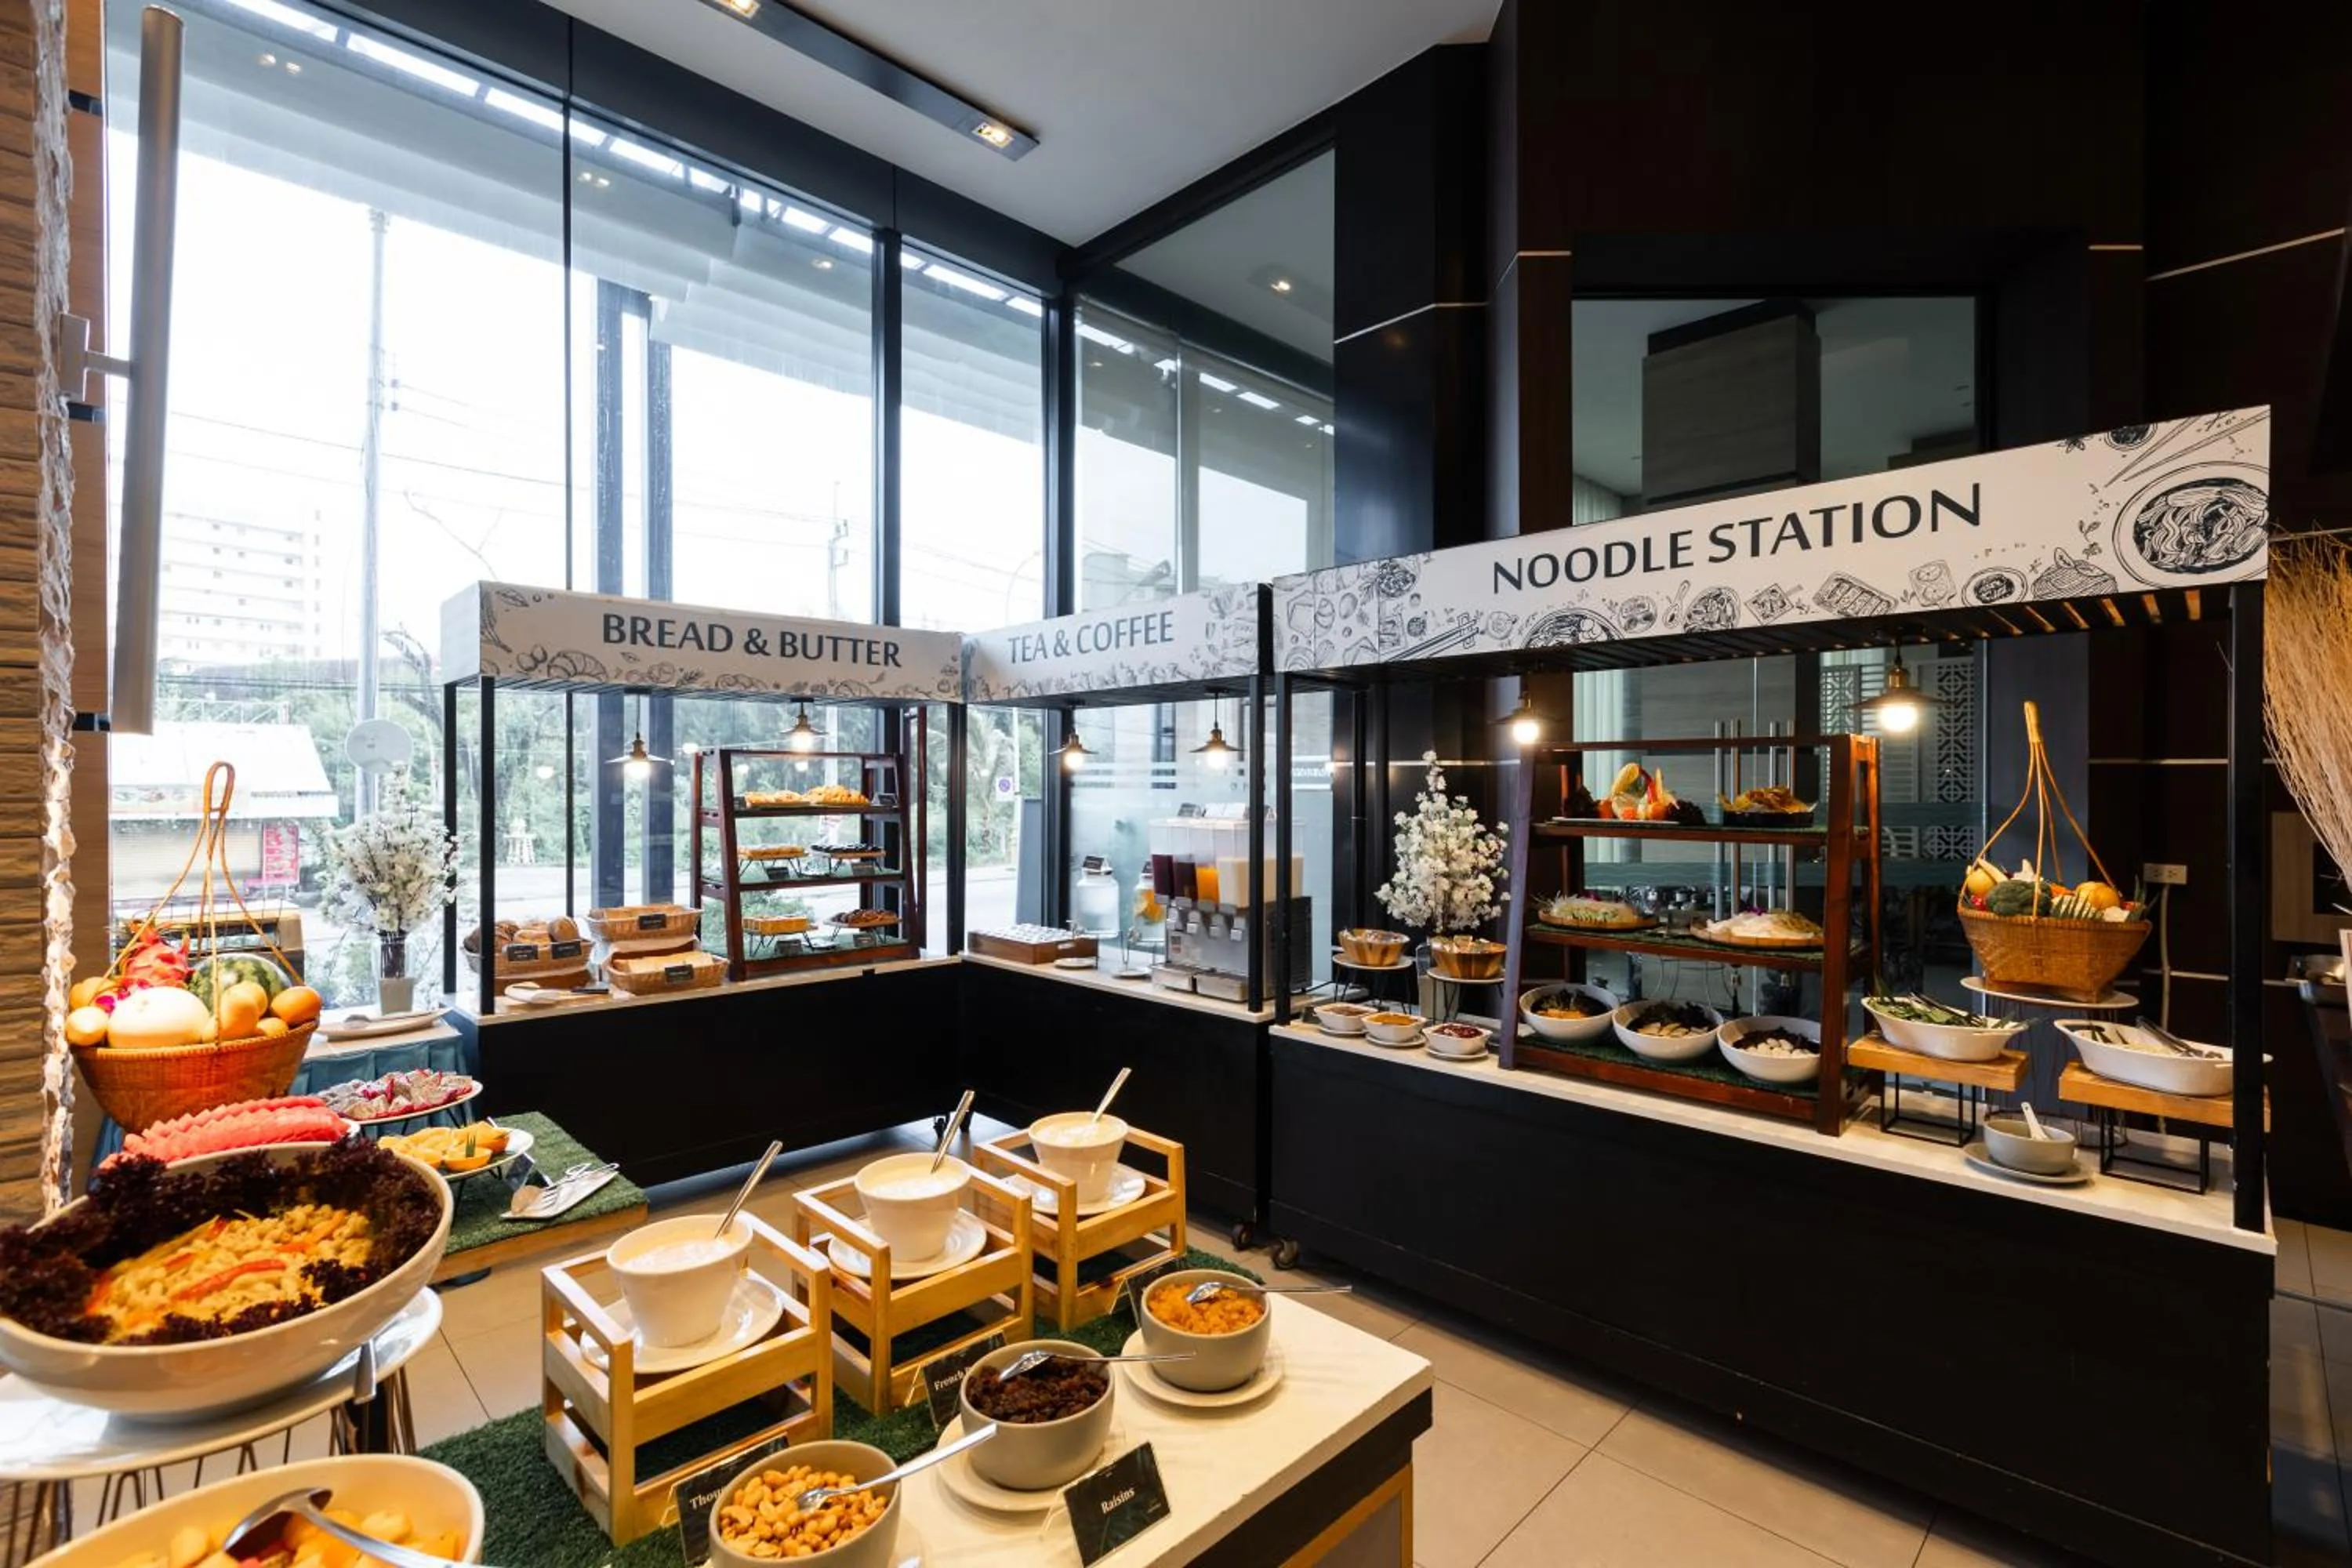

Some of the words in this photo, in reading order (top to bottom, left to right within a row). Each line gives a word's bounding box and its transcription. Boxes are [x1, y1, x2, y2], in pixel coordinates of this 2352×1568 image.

[1493, 528, 1694, 595] NOODLE
[1708, 482, 1981, 564] STATION
[602, 612, 734, 653] BREAD
[742, 627, 771, 657] &
[779, 630, 903, 668] BUTTER
[1007, 632, 1048, 664] TEA
[1053, 629, 1072, 657] &
[1076, 611, 1175, 655] COFFEE
[933, 1369, 965, 1392] French
[1100, 1486, 1136, 1515] Raisins
